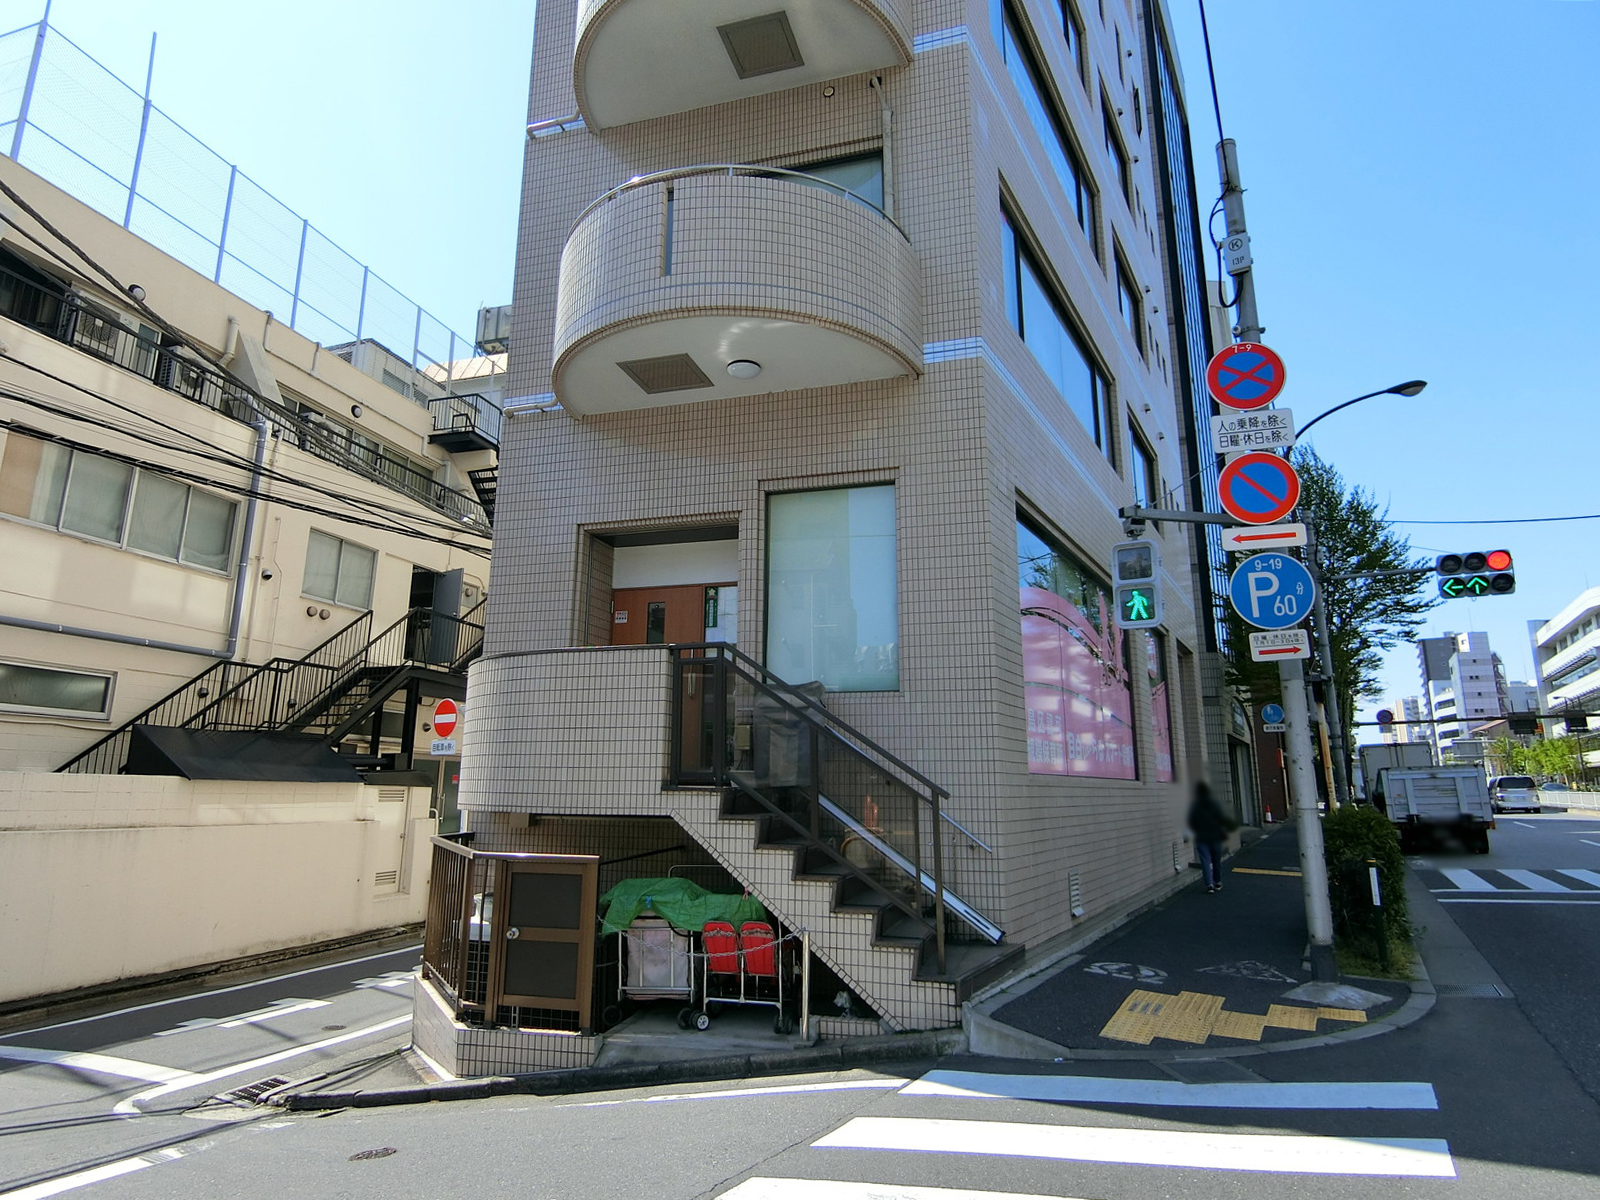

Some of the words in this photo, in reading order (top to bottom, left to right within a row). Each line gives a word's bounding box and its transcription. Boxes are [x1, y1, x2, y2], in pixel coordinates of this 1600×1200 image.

[1232, 344, 1252, 353] 7-9
[1218, 415, 1287, 432] 人の乗降を除く
[1254, 558, 1282, 571] 9-19
[1248, 571, 1279, 618] P
[1274, 595, 1297, 616] 60
